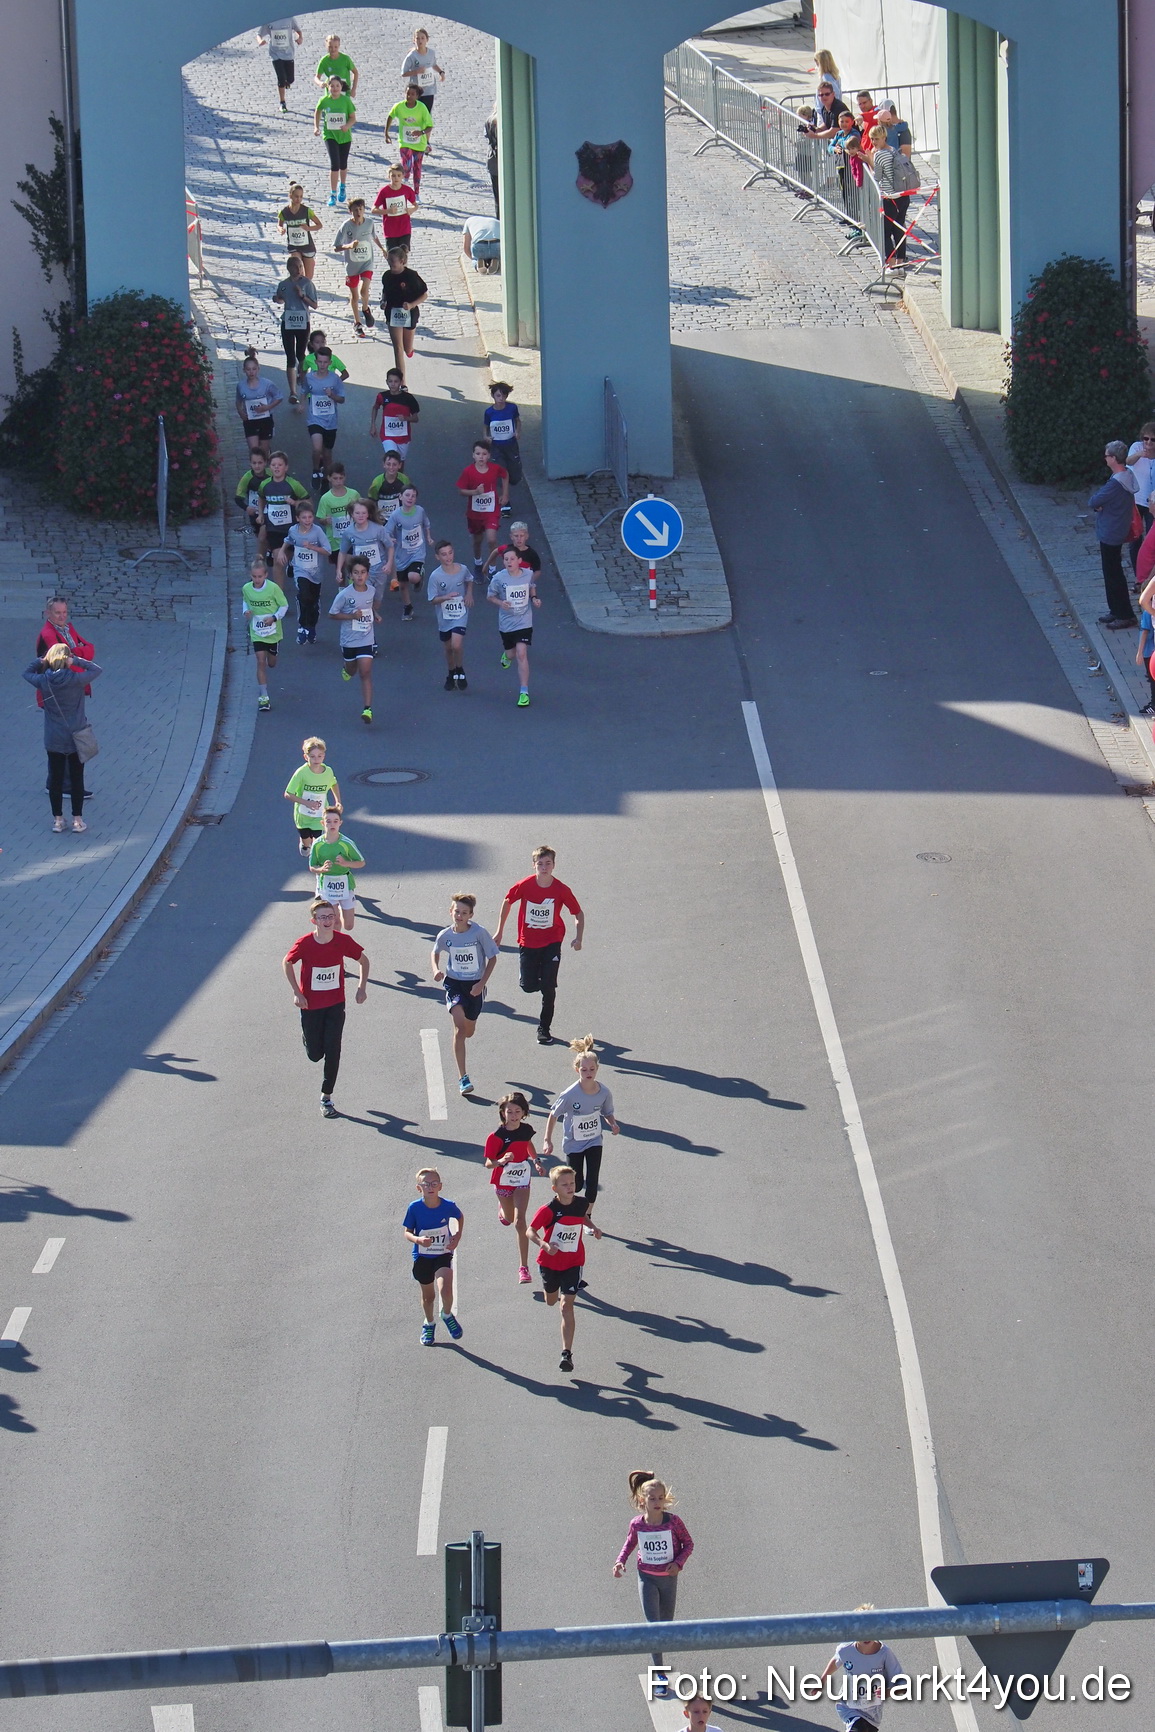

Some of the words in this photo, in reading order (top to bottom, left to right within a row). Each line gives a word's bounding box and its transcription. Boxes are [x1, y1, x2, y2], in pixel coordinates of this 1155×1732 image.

[291, 231, 306, 239] 4024
[316, 400, 332, 408] 4036
[388, 421, 404, 429] 4044
[494, 425, 510, 433] 4039
[476, 497, 492, 505] 4000
[271, 509, 288, 518] 4029
[405, 532, 420, 542] 4034
[298, 552, 313, 560] 4051
[510, 590, 527, 599] 4003
[445, 603, 462, 611] 4014
[327, 881, 345, 890] 4009
[530, 908, 550, 917] 4038
[455, 953, 474, 963] 4006
[316, 972, 335, 981] 4041
[578, 1119, 598, 1131] 4035
[430, 1234, 446, 1244] 017
[557, 1231, 576, 1242] 4042
[643, 1540, 668, 1552] 4033
